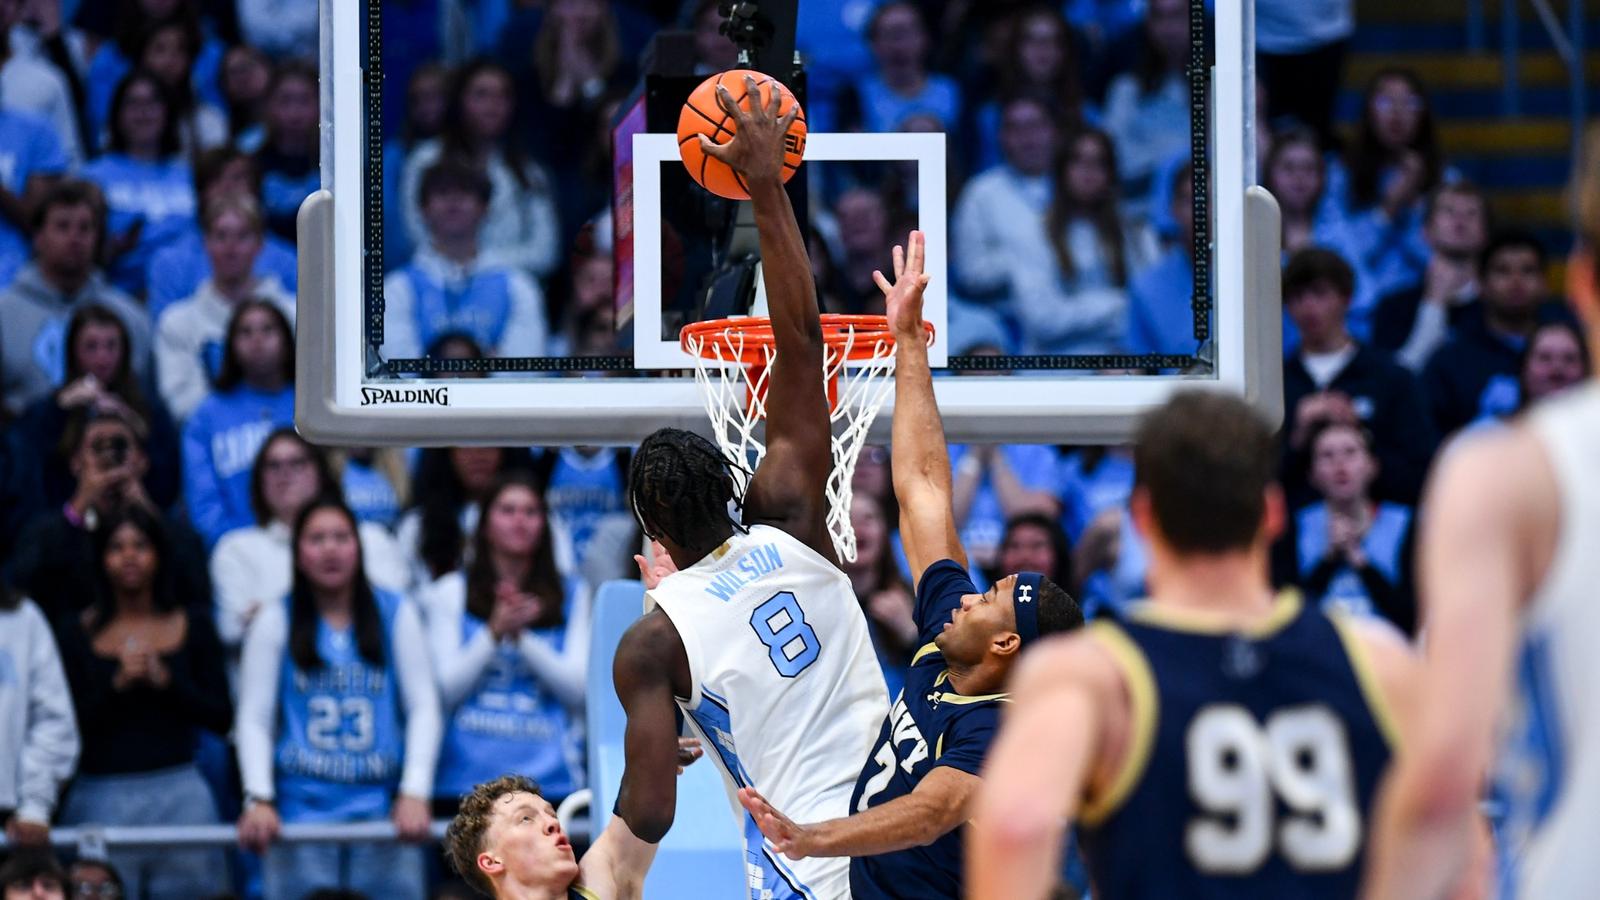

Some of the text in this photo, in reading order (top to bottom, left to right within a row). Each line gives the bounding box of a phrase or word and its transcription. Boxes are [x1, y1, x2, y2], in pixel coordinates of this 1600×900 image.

[361, 387, 449, 406] SPALDING
[704, 542, 784, 602] WILSON
[749, 590, 822, 678] 8
[307, 695, 374, 752] 23
[857, 740, 896, 812] 2
[1185, 702, 1362, 874] 99
